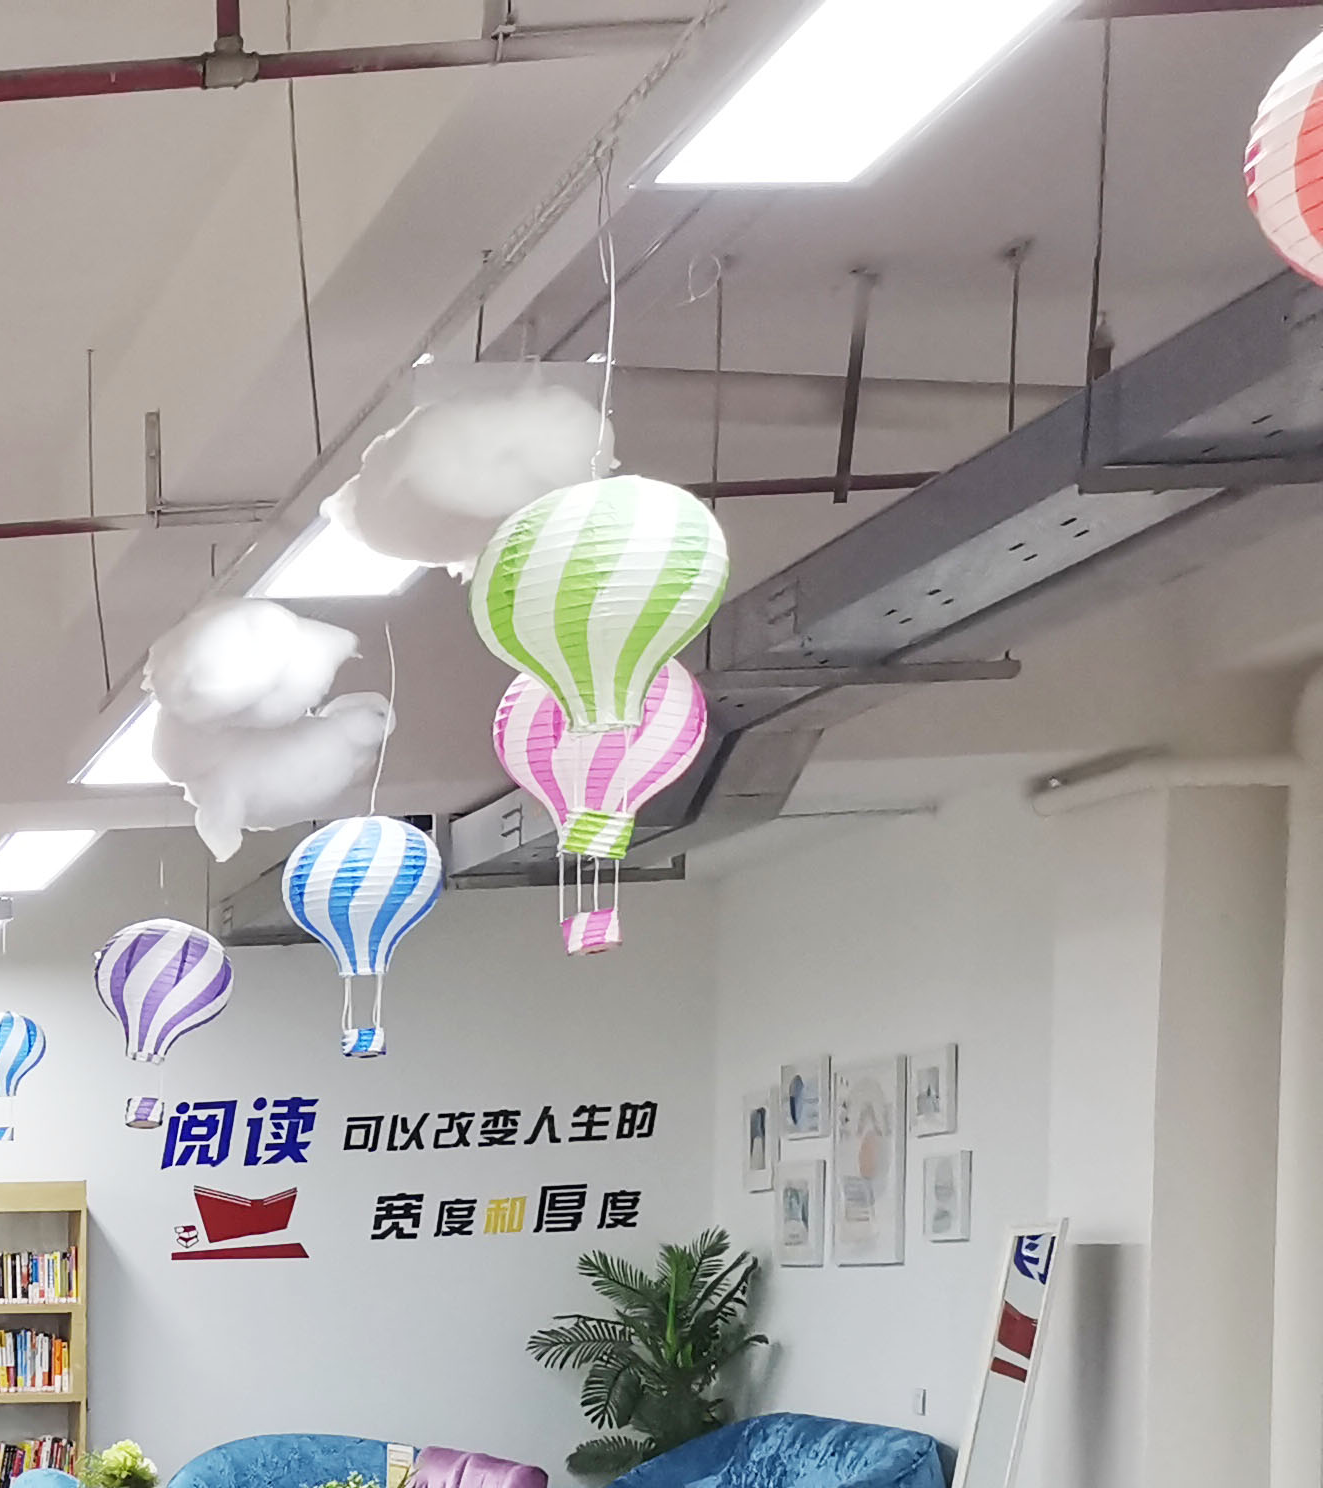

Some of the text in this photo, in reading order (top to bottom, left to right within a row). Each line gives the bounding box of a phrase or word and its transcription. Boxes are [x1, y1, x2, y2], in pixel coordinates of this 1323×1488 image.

[161, 1097, 658, 1169] 阅读 可以改变人生的
[370, 1183, 642, 1241] 宽度和厚度
